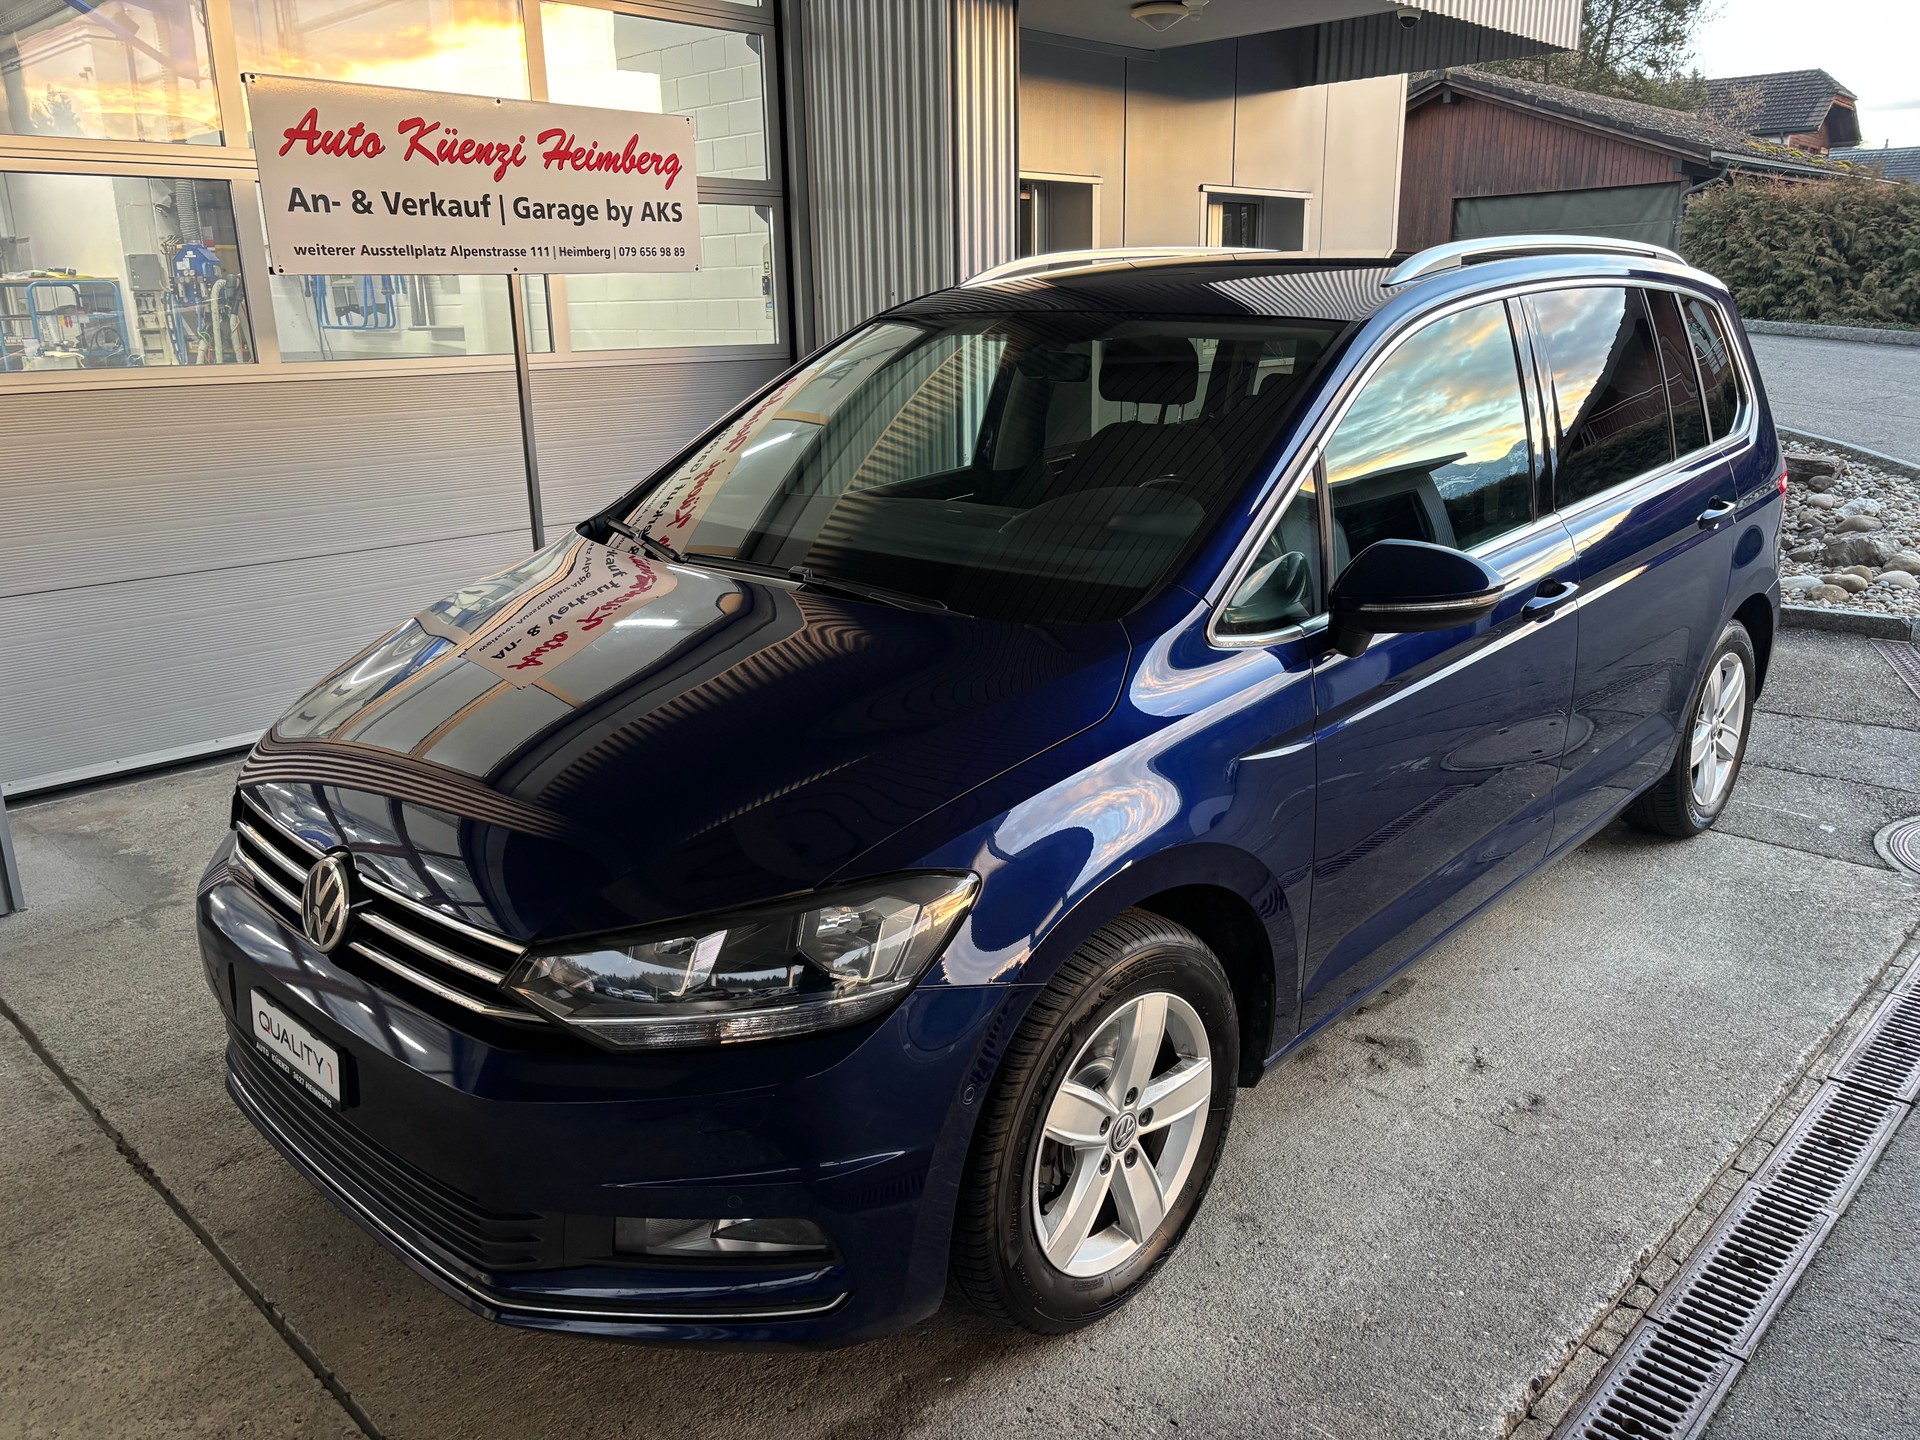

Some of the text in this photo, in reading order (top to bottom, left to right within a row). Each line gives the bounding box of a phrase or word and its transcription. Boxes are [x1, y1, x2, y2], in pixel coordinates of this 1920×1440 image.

[278, 107, 683, 190] Auto Küenzi Heimberg
[287, 187, 341, 214] An-
[351, 189, 374, 215] &
[380, 190, 492, 219] Verkauf
[512, 196, 599, 228] Garage
[606, 198, 633, 228] by
[640, 201, 684, 223] AKS
[293, 243, 356, 257] weiterer
[360, 244, 447, 260] Ausstellplatz
[450, 245, 528, 260] Alpenstrasse
[530, 246, 550, 257] 111
[558, 246, 611, 260] Heimberg
[618, 246, 637, 257] 079
[639, 246, 657, 257] 656
[659, 246, 672, 257] 98
[673, 246, 686, 258] 89
[256, 1041, 270, 1057] AUTO
[258, 1010, 324, 1075] QUALITY
